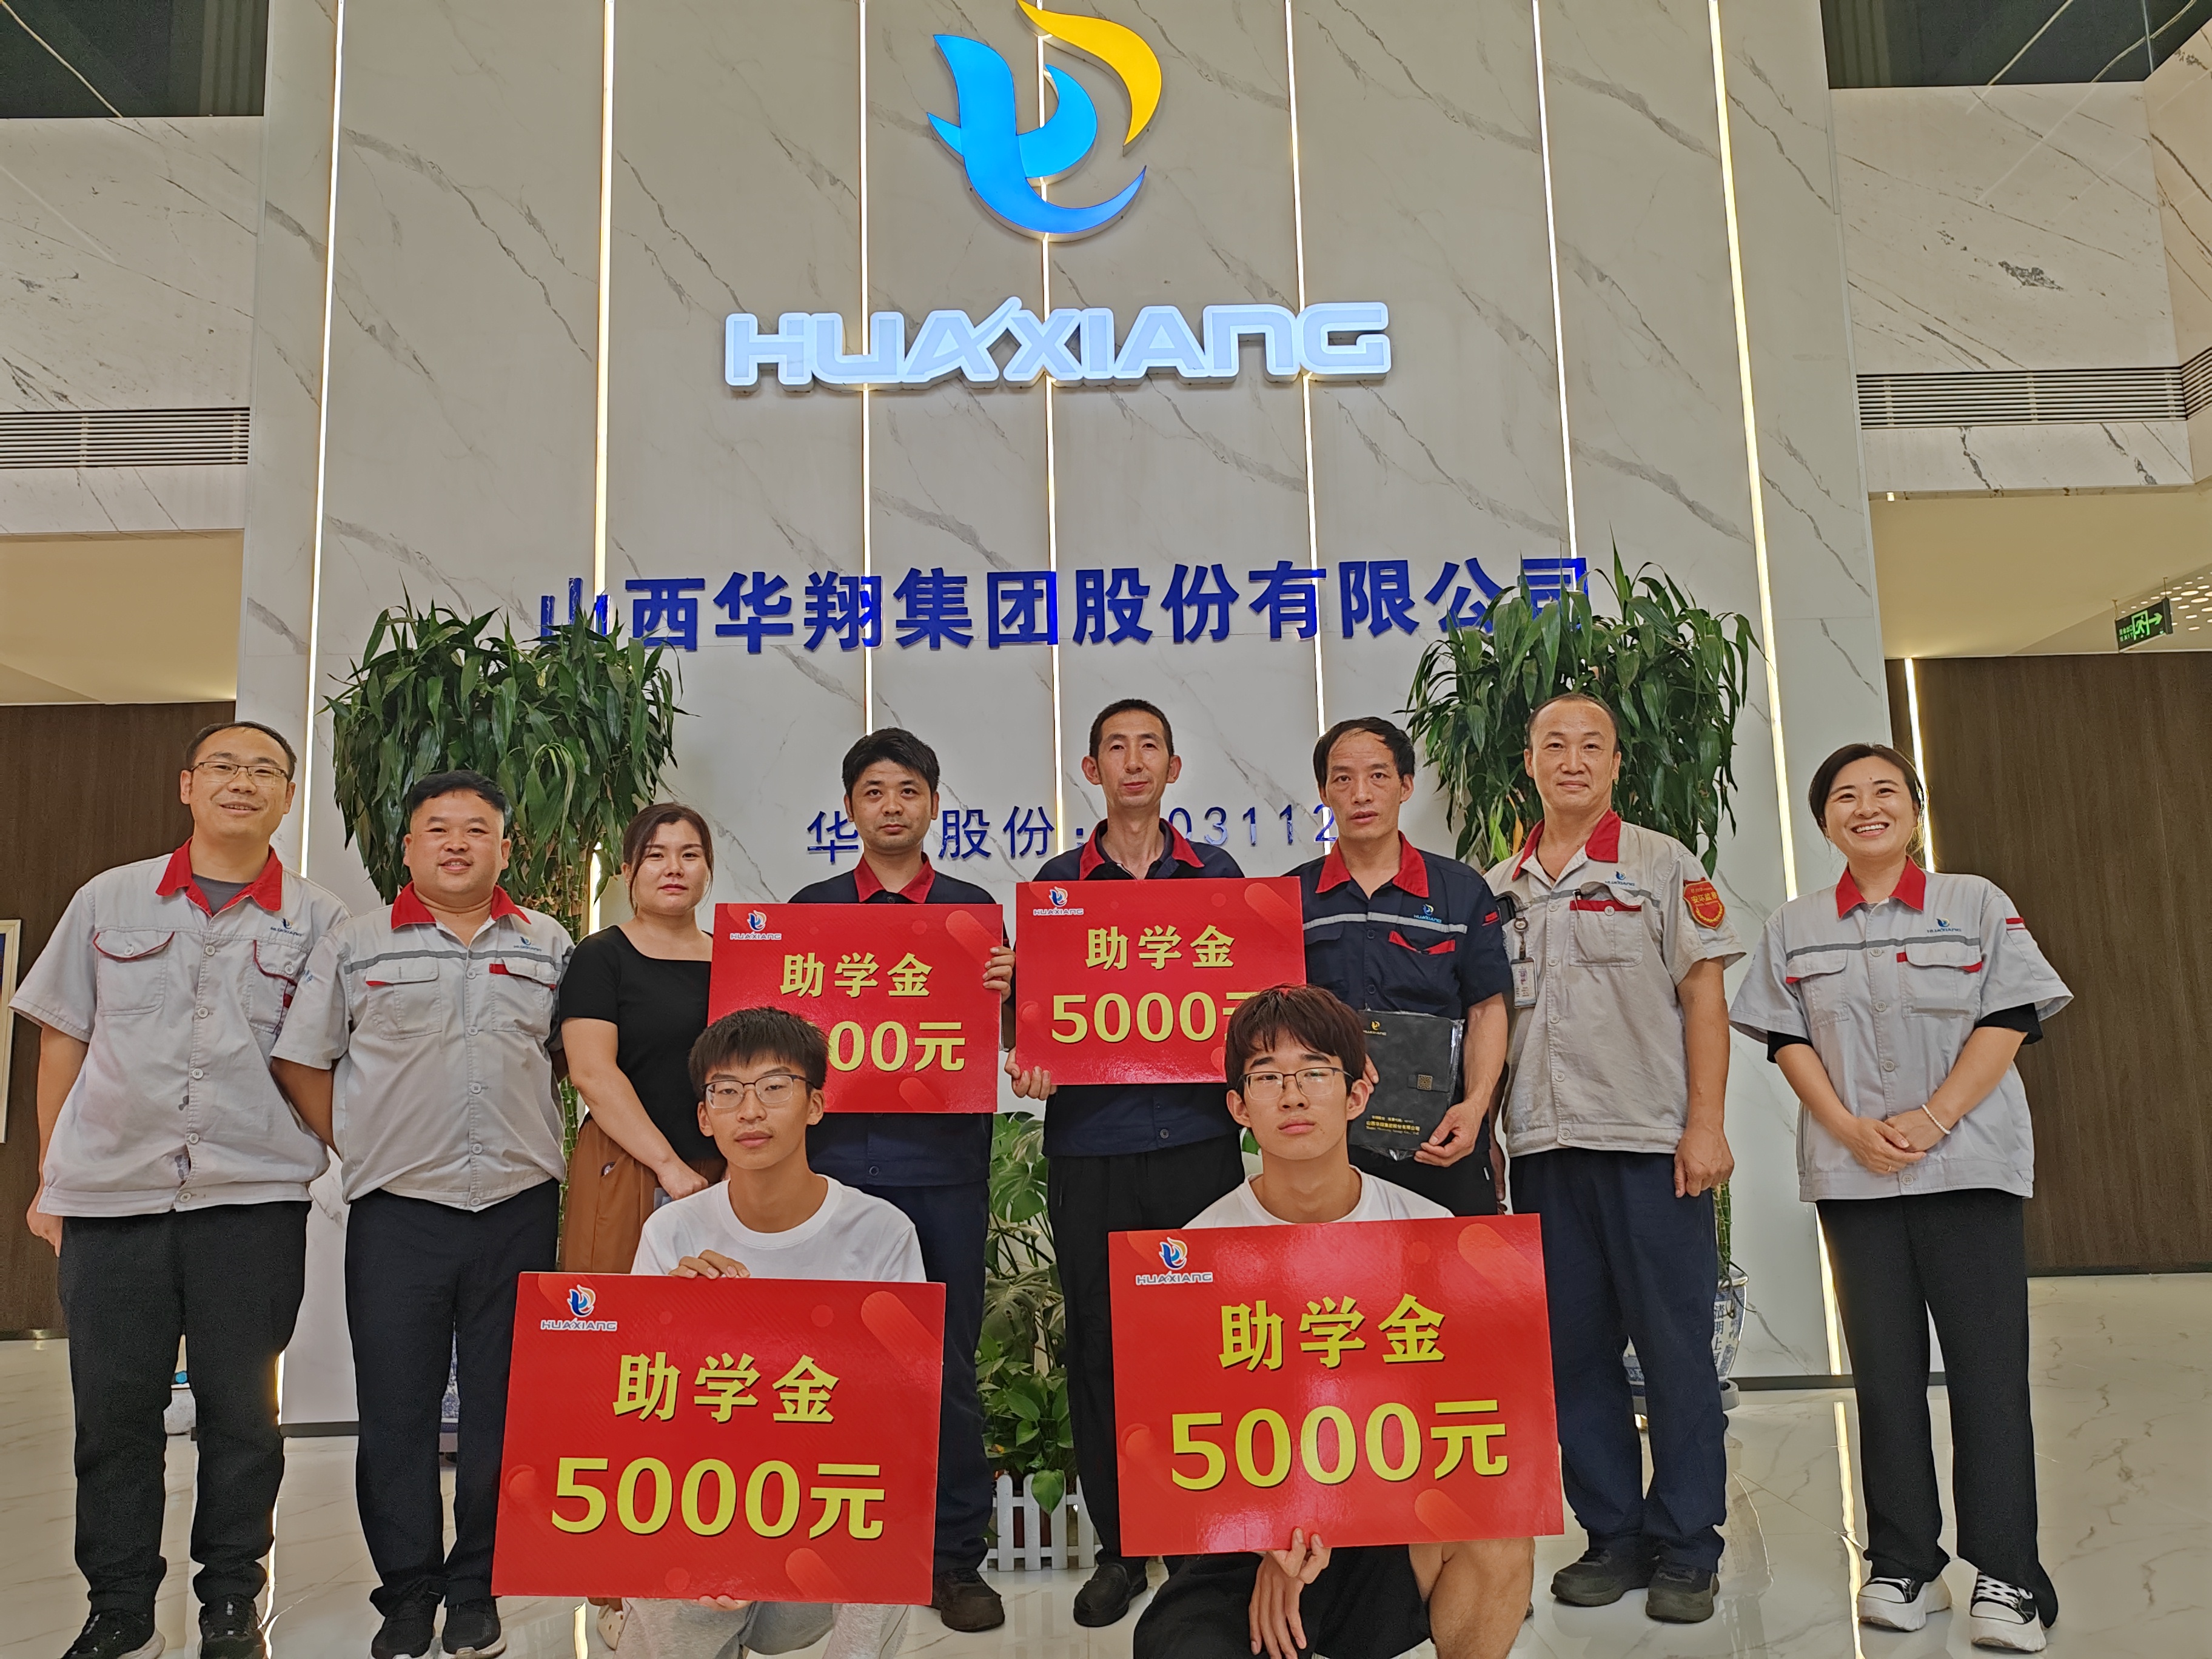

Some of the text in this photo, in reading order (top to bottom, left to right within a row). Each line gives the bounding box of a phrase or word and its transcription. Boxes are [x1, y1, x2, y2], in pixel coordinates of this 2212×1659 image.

[726, 297, 1390, 387] HUAXIANG
[780, 952, 933, 998] 助学金
[1085, 925, 1235, 971] 助学金
[806, 1021, 965, 1072] 00元
[1136, 1270, 1213, 1285] HUAXIANG
[540, 1318, 617, 1332] HUAXIANG
[1218, 1293, 1445, 1371] 助学金
[612, 1352, 840, 1423] 助学金
[1171, 1399, 1508, 1490] 5000元
[551, 1456, 885, 1540] 5000元
